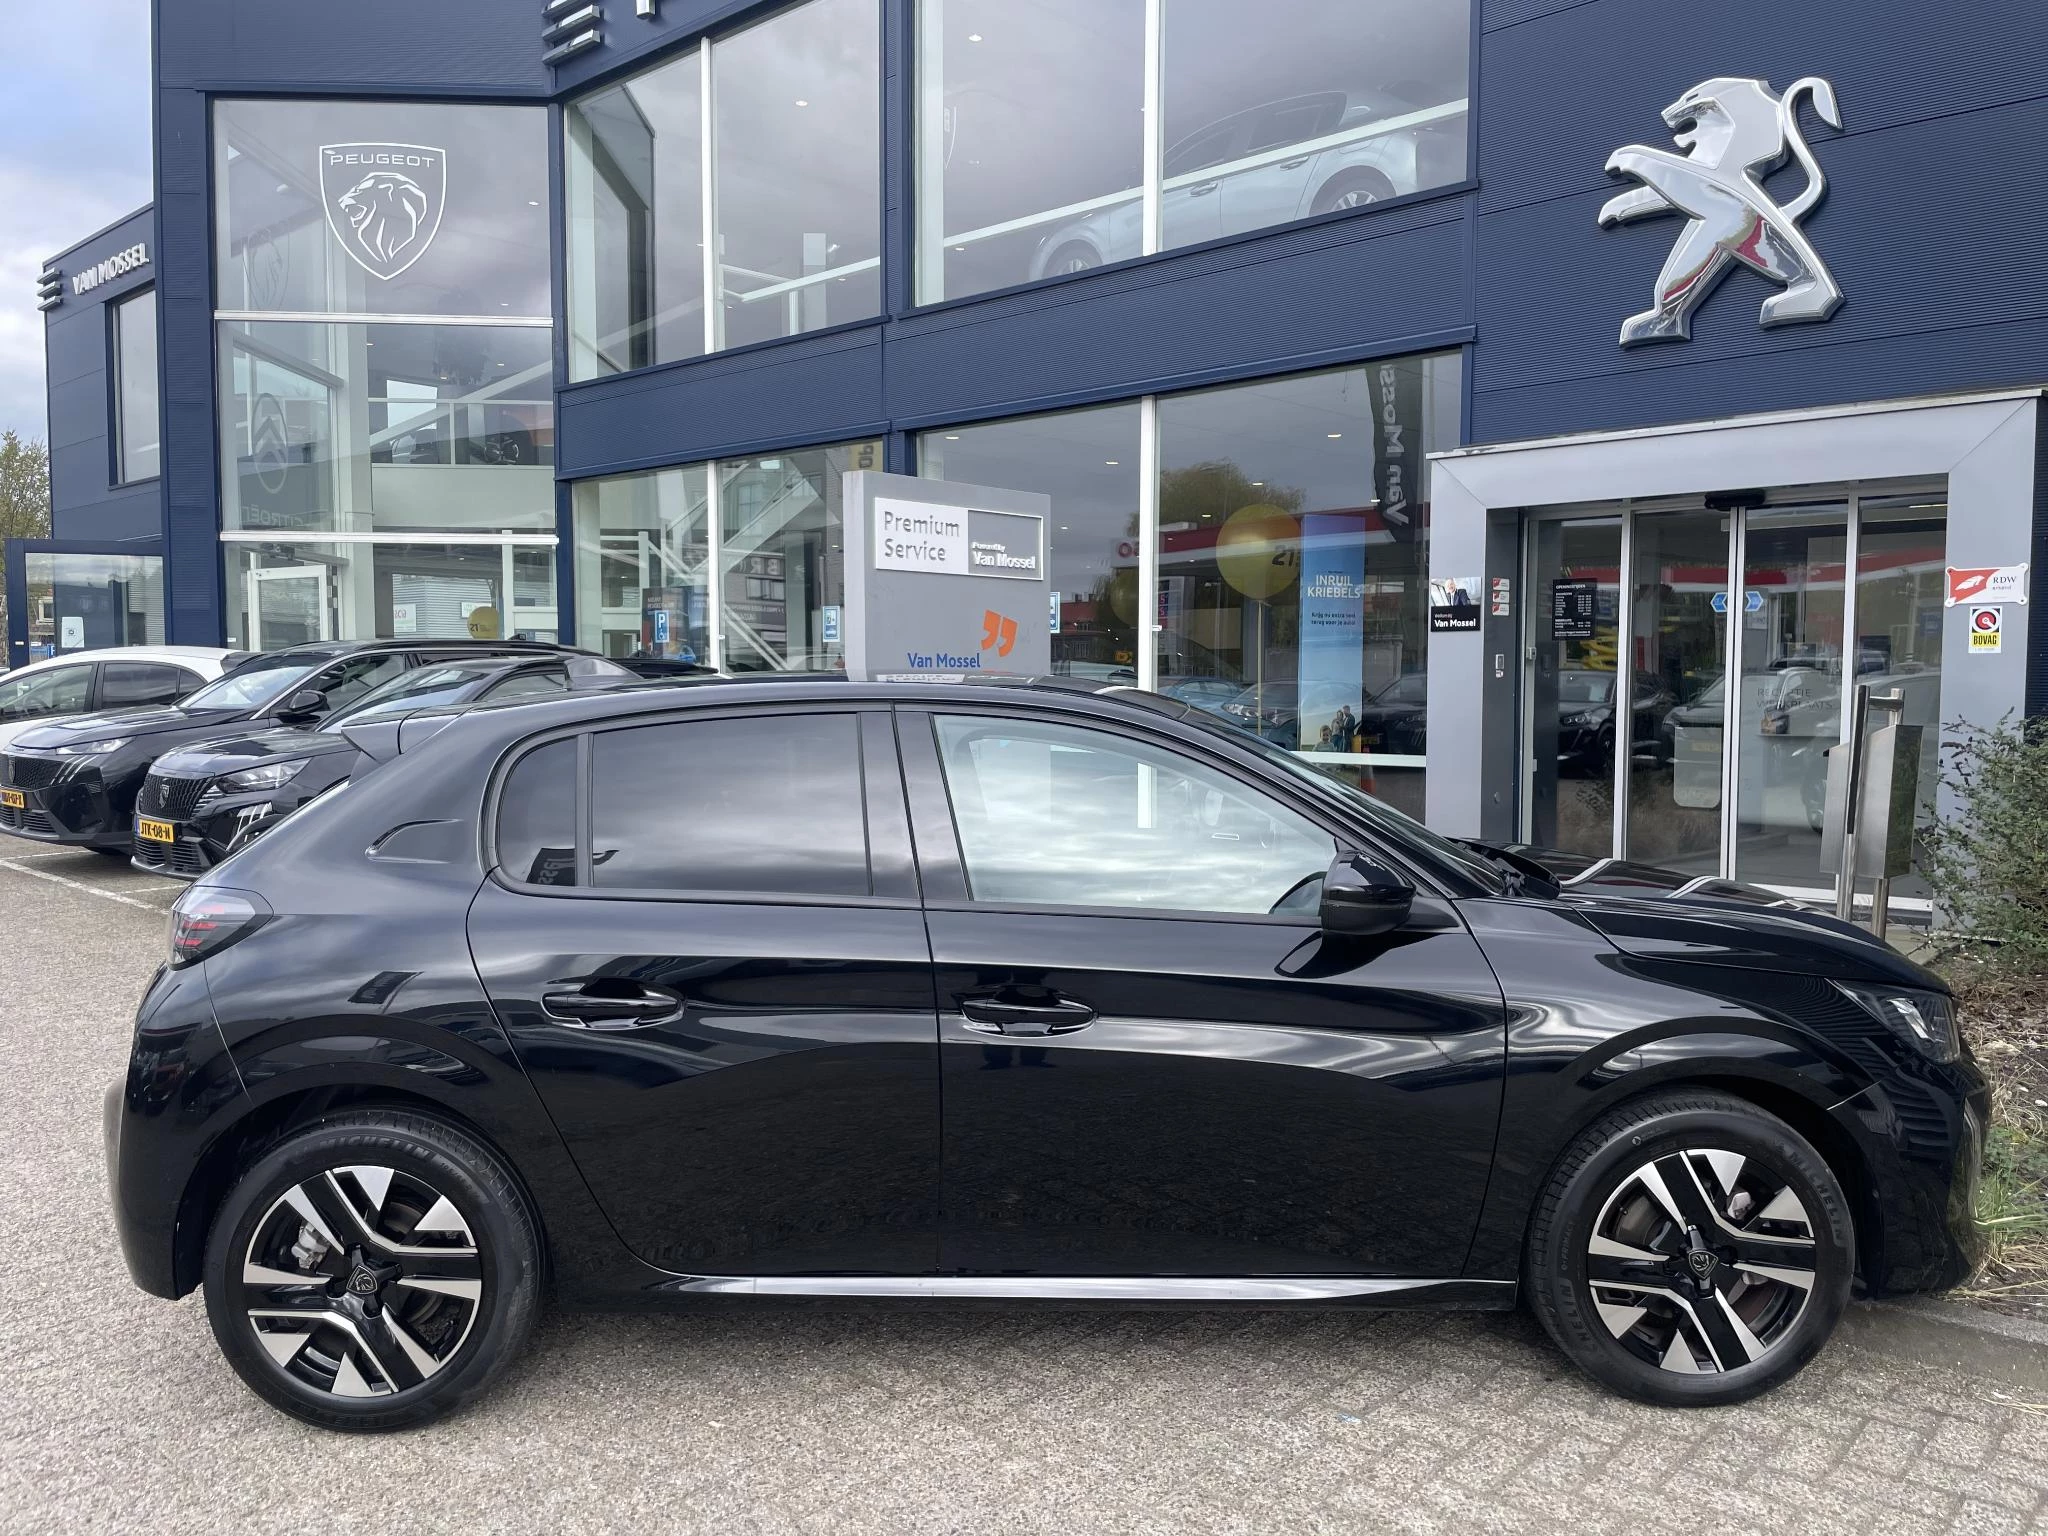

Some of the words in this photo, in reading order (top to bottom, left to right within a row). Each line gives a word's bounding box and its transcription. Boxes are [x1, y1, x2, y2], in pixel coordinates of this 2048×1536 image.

[330, 153, 435, 168] PEUGEOT
[72, 266, 98, 295] VAN
[98, 242, 150, 284] MOSSEL
[884, 511, 960, 537] Premium
[884, 538, 946, 561] Service
[973, 551, 995, 566] Van
[997, 552, 1035, 569] Mossel
[1315, 575, 1353, 586] INRUIL
[1993, 576, 2016, 584] RDW
[1307, 586, 1361, 599] KRIEBELS
[658, 614, 666, 628] P
[1434, 619, 1449, 628] Van
[1450, 618, 1476, 628] Mossel
[1973, 634, 1998, 646] BOVAG
[907, 652, 933, 669] Van
[936, 652, 981, 669] Mossel
[1757, 688, 1814, 697] RECPTIE
[141, 821, 171, 840] JTK-08-N
